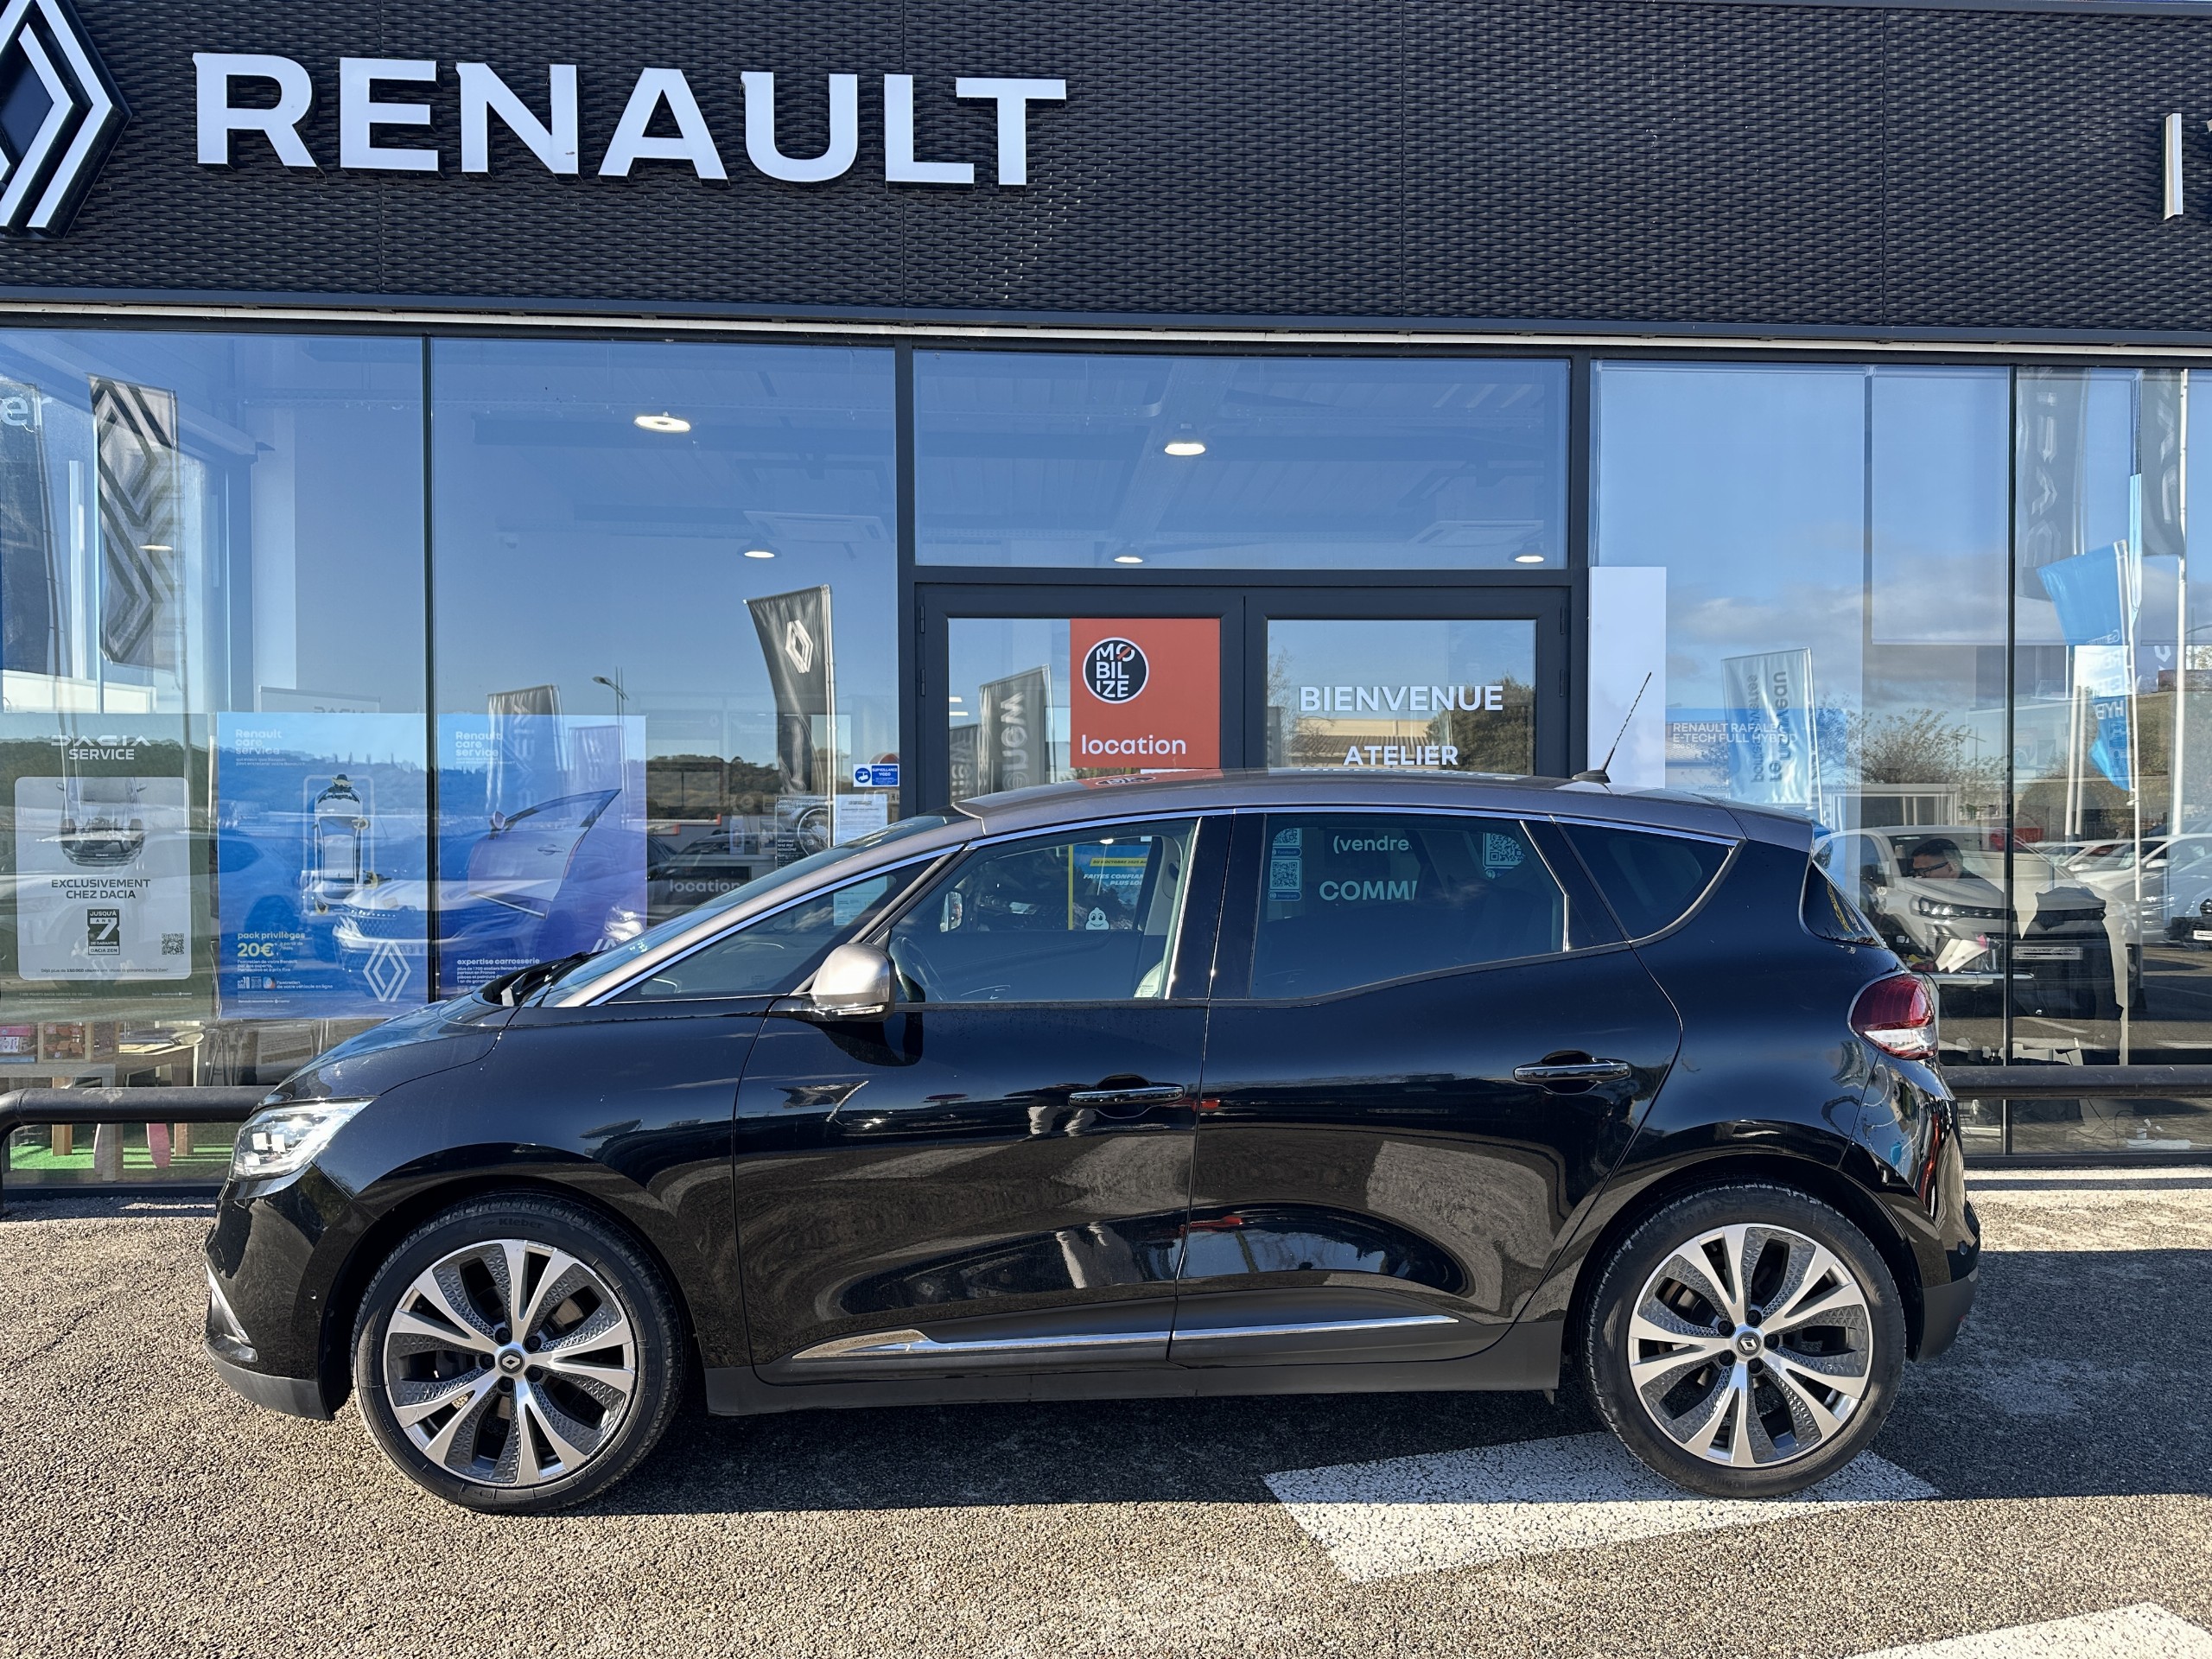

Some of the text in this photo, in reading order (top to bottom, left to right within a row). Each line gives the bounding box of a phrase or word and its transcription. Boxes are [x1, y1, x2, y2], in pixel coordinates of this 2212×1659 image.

[191, 52, 1068, 187] RENAULT
[1096, 661, 1129, 679] BIL
[1096, 680, 1129, 697] IZE
[1300, 686, 1503, 711] BIENVENUE
[1673, 722, 1777, 733] RENAULT RAFALE
[235, 728, 283, 739] Renault
[455, 731, 503, 741] Renault
[1673, 734, 1716, 743] E-TECH
[1719, 734, 1750, 743] FULL
[51, 734, 151, 747] DACIA
[235, 738, 263, 747] care
[1082, 734, 1186, 755] location
[68, 748, 135, 760] SERVICE
[235, 746, 280, 755] service
[455, 747, 499, 757] service
[1343, 746, 1459, 766] ATELIER
[1332, 835, 1413, 854] (vendre
[51, 879, 151, 888] EXCLUSIVEMENT
[66, 890, 136, 899] CHEZ DACIA
[1319, 880, 1417, 900] COMM
[238, 931, 260, 941] pack
[456, 957, 493, 966] expertise
[499, 1217, 545, 1229] Kleber
